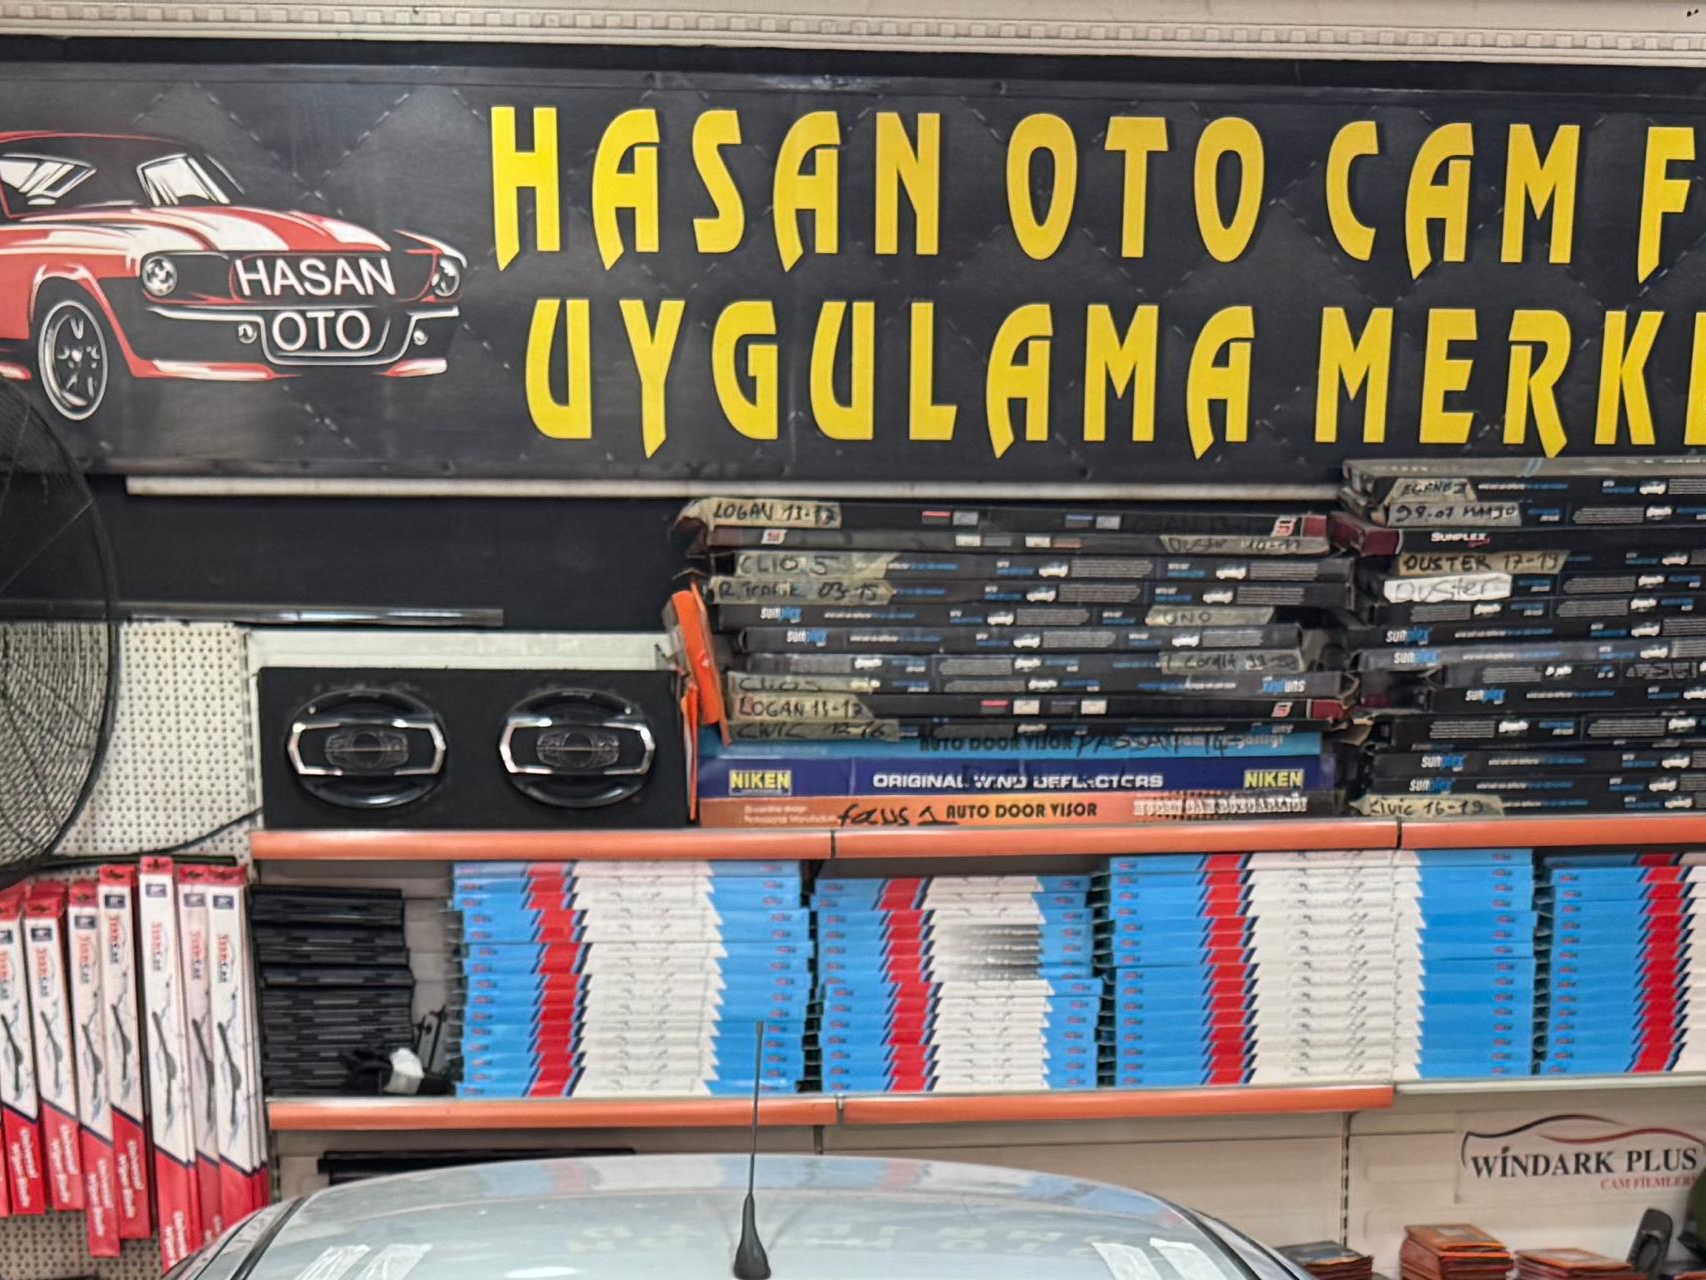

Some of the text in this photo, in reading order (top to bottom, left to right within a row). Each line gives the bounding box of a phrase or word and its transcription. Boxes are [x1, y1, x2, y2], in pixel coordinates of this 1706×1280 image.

[492, 106, 942, 271] HASAN
[1007, 113, 1266, 263] OTO
[1326, 121, 1582, 280] CAM
[236, 256, 395, 298] HASAN
[272, 310, 372, 351] OTO
[525, 299, 1256, 459] UYGULAMA
[730, 772, 791, 790] NIKEN
[872, 773, 969, 789] ORIGINAL
[1244, 771, 1304, 788] NIKEN
[946, 801, 1099, 820] AUTO DOOR VISOR
[1626, 1148, 1697, 1172] PLUS
